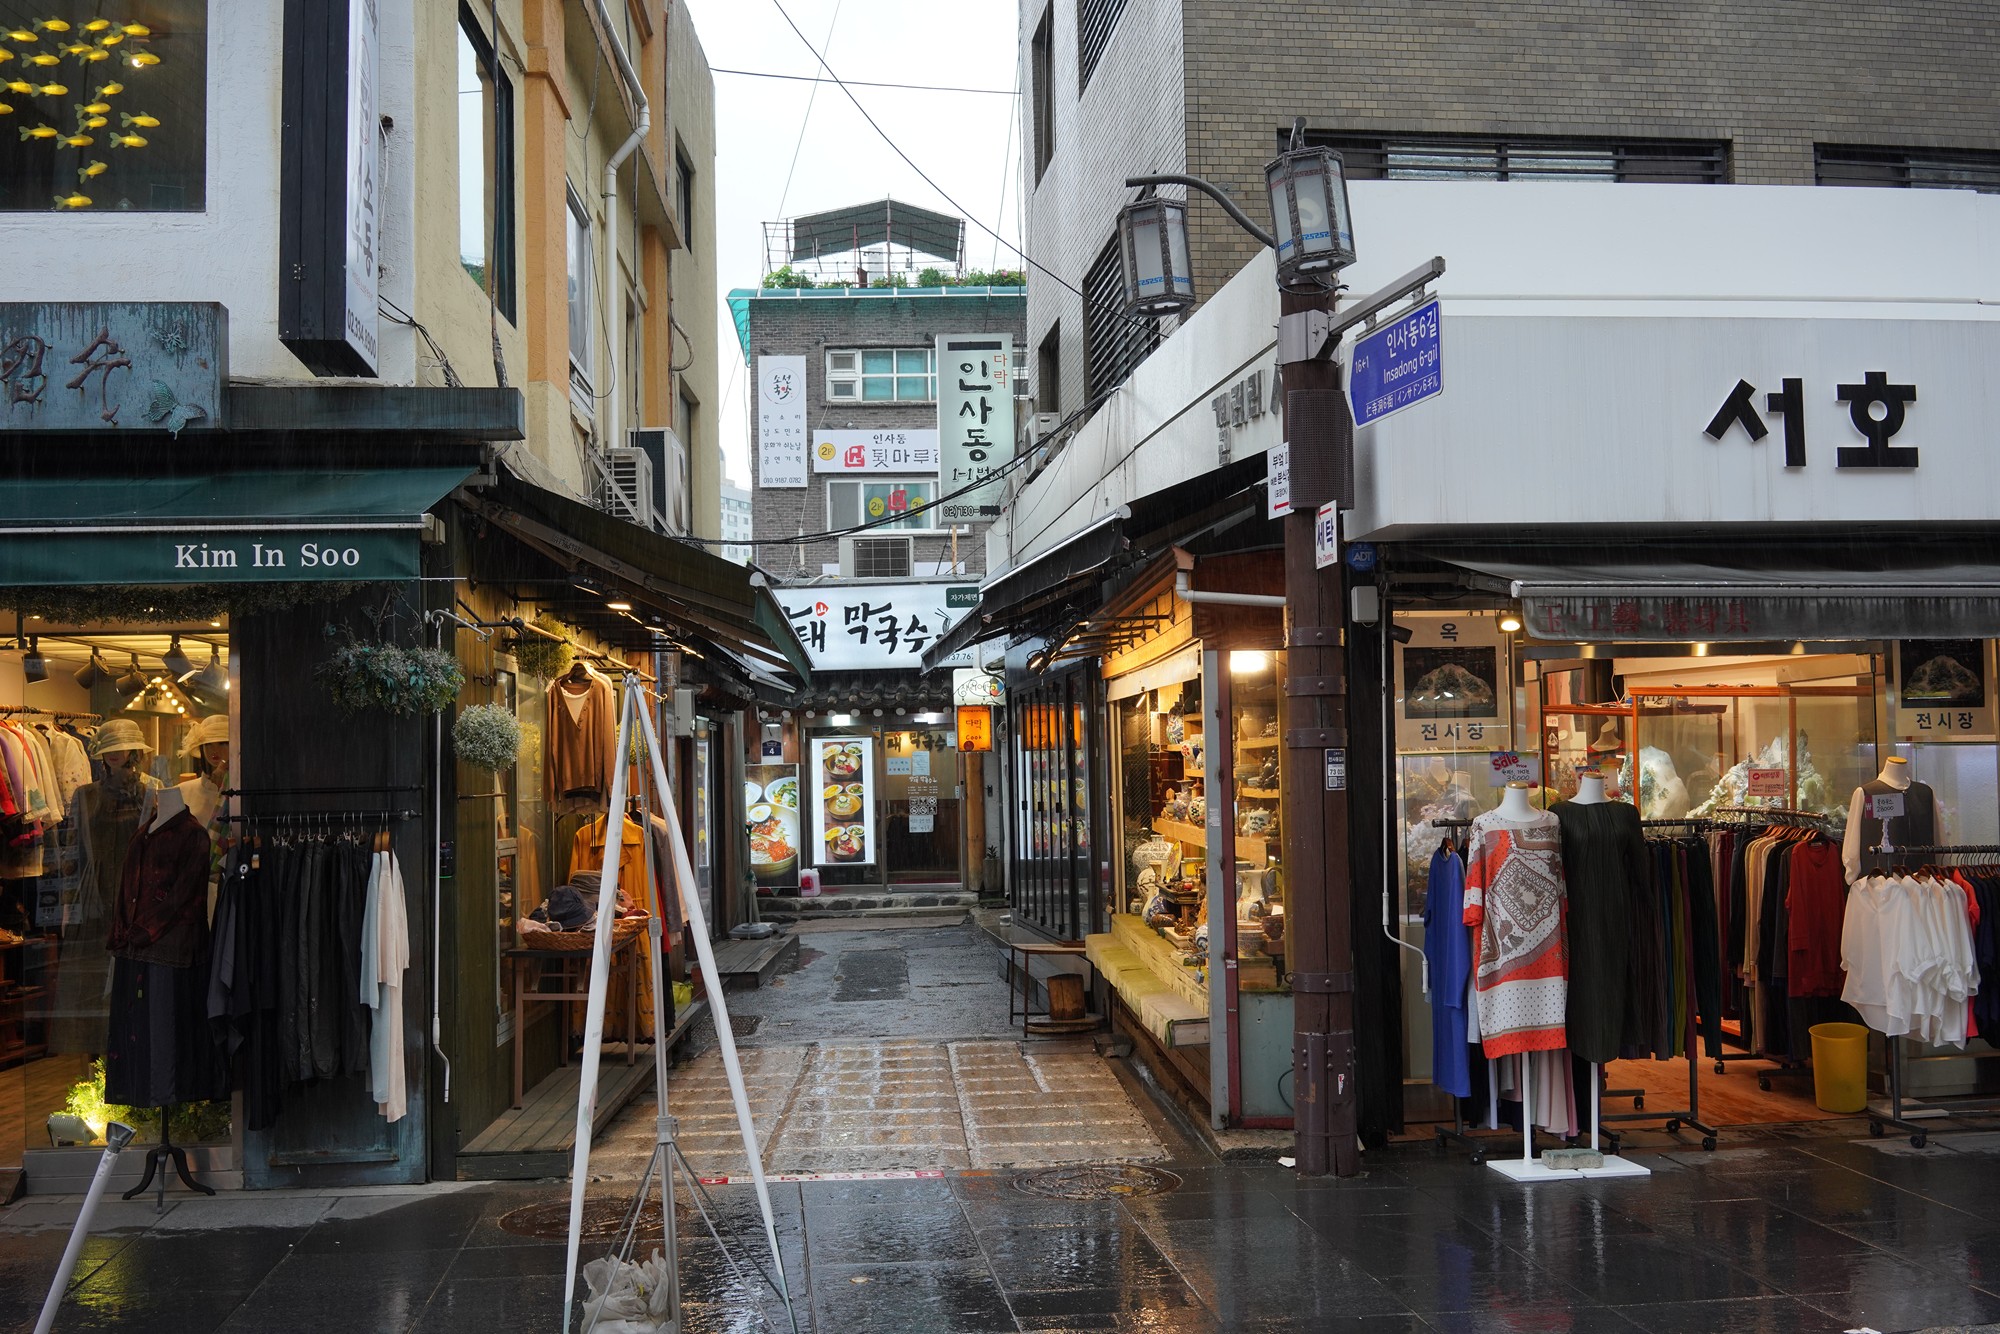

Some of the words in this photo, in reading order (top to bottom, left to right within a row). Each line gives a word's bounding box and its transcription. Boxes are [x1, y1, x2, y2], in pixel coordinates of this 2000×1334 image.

[1386, 307, 1437, 358] 인사동6길
[994, 353, 1007, 388] 다락
[1383, 358, 1418, 384] Insadong
[1419, 343, 1438, 367] 6-gil
[959, 360, 993, 462] 인사동
[1703, 371, 1919, 468] 서호
[873, 433, 907, 444] 인사동
[1317, 517, 1334, 551] 세탁
[175, 543, 238, 568] Kim
[252, 543, 286, 567] In
[301, 543, 360, 567] Soo
[1352, 551, 1372, 562] ADT
[844, 602, 932, 654] 막국수
[1440, 622, 1459, 642] 옥
[1421, 722, 1484, 741] 전시장
[1916, 712, 1974, 730] 전시장
[769, 747, 775, 755] 4
[1491, 753, 1519, 771] Sale
